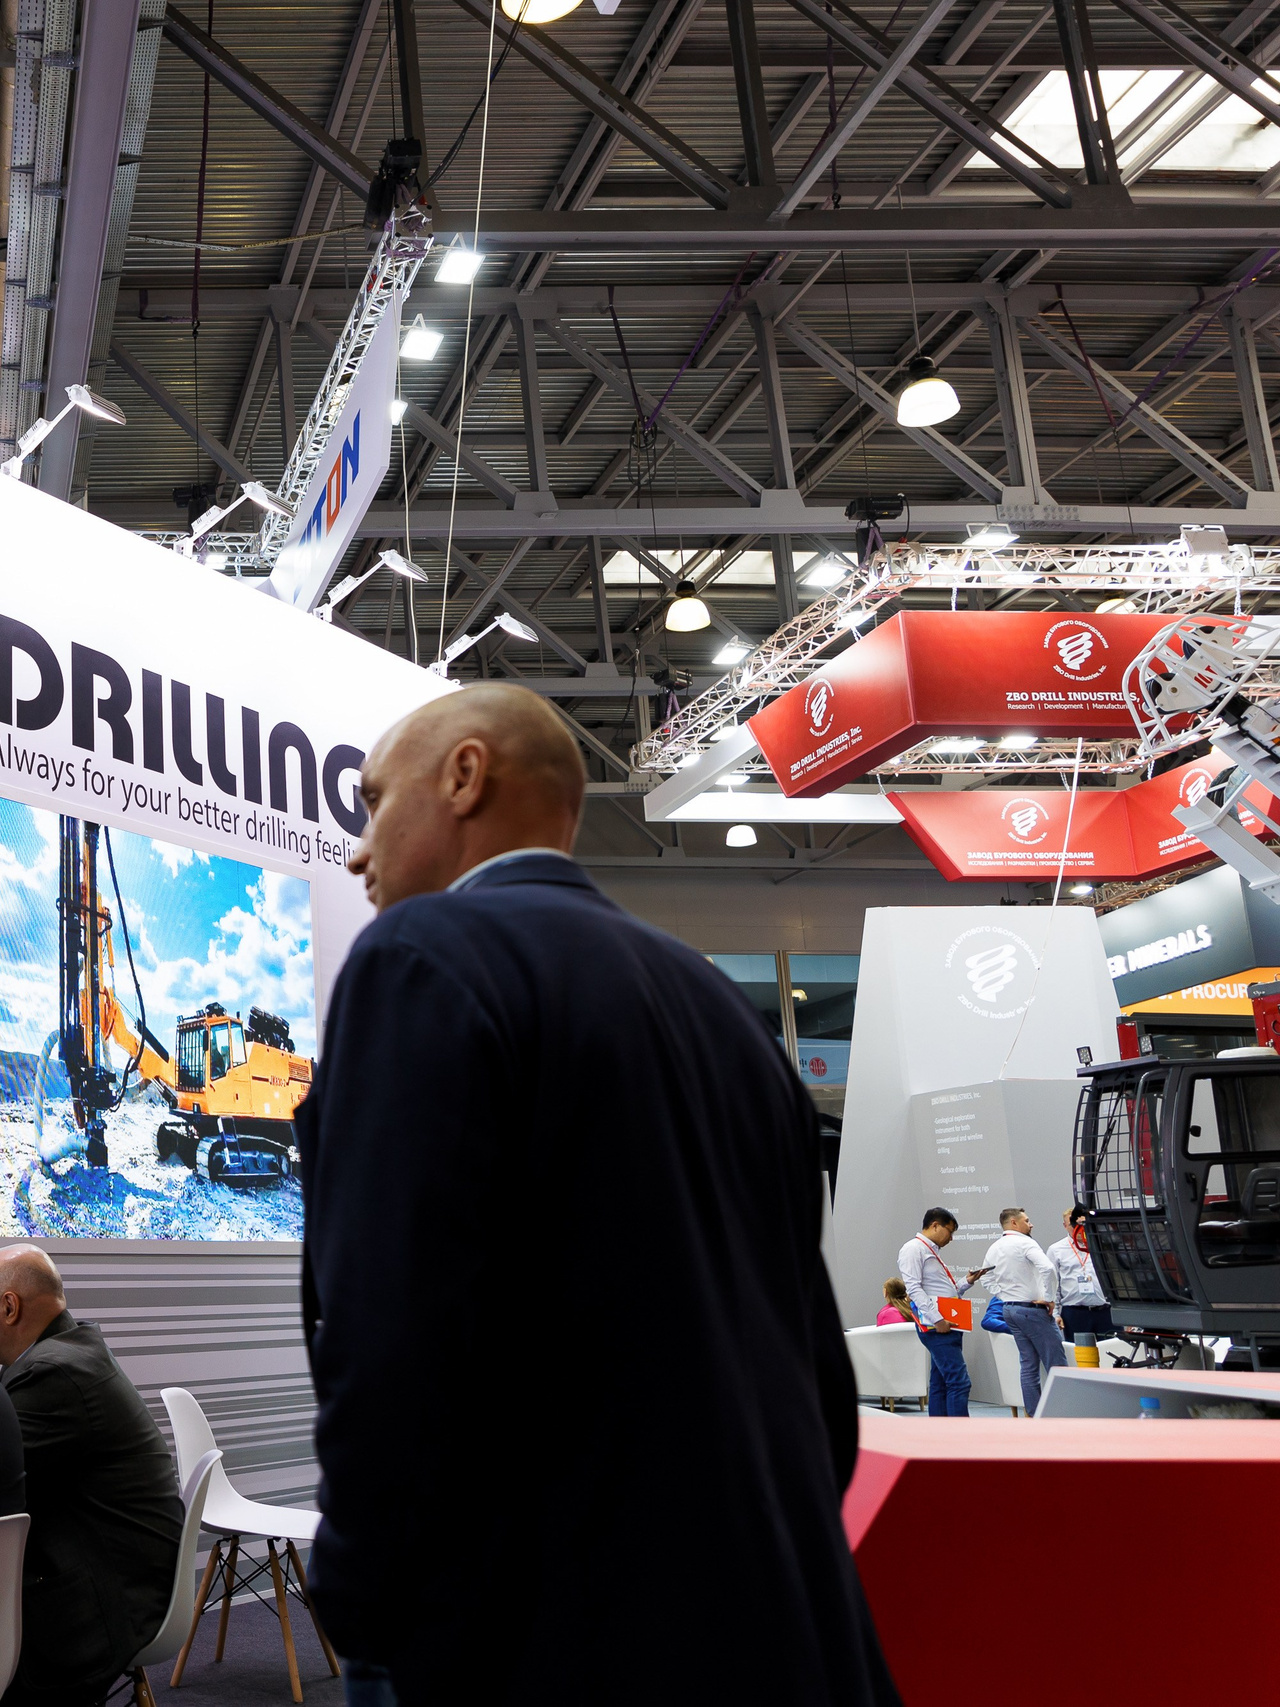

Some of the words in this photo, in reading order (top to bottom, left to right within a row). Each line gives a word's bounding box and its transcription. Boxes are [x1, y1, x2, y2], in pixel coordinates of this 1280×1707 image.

[1006, 692, 1029, 701] ZBO
[1031, 692, 1066, 701] DRILL
[1067, 692, 1140, 703] INDUSTRIS,
[790, 760, 801, 773] ZBO
[800, 752, 816, 767] DRILL
[816, 731, 850, 758] INDUSTRIES,
[850, 725, 862, 737] Inc.
[82, 757, 115, 798] for
[121, 778, 172, 815] your
[178, 786, 240, 835] better
[245, 810, 311, 864] drilling
[967, 852, 993, 860] ЗАВОД
[1033, 852, 1094, 860] ОБОРУДОВАНИЯ
[944, 943, 959, 969] ЗАВОД
[954, 925, 991, 946] БУРОВОГО
[957, 993, 974, 1009] ZBO
[973, 1005, 989, 1018] Drill
